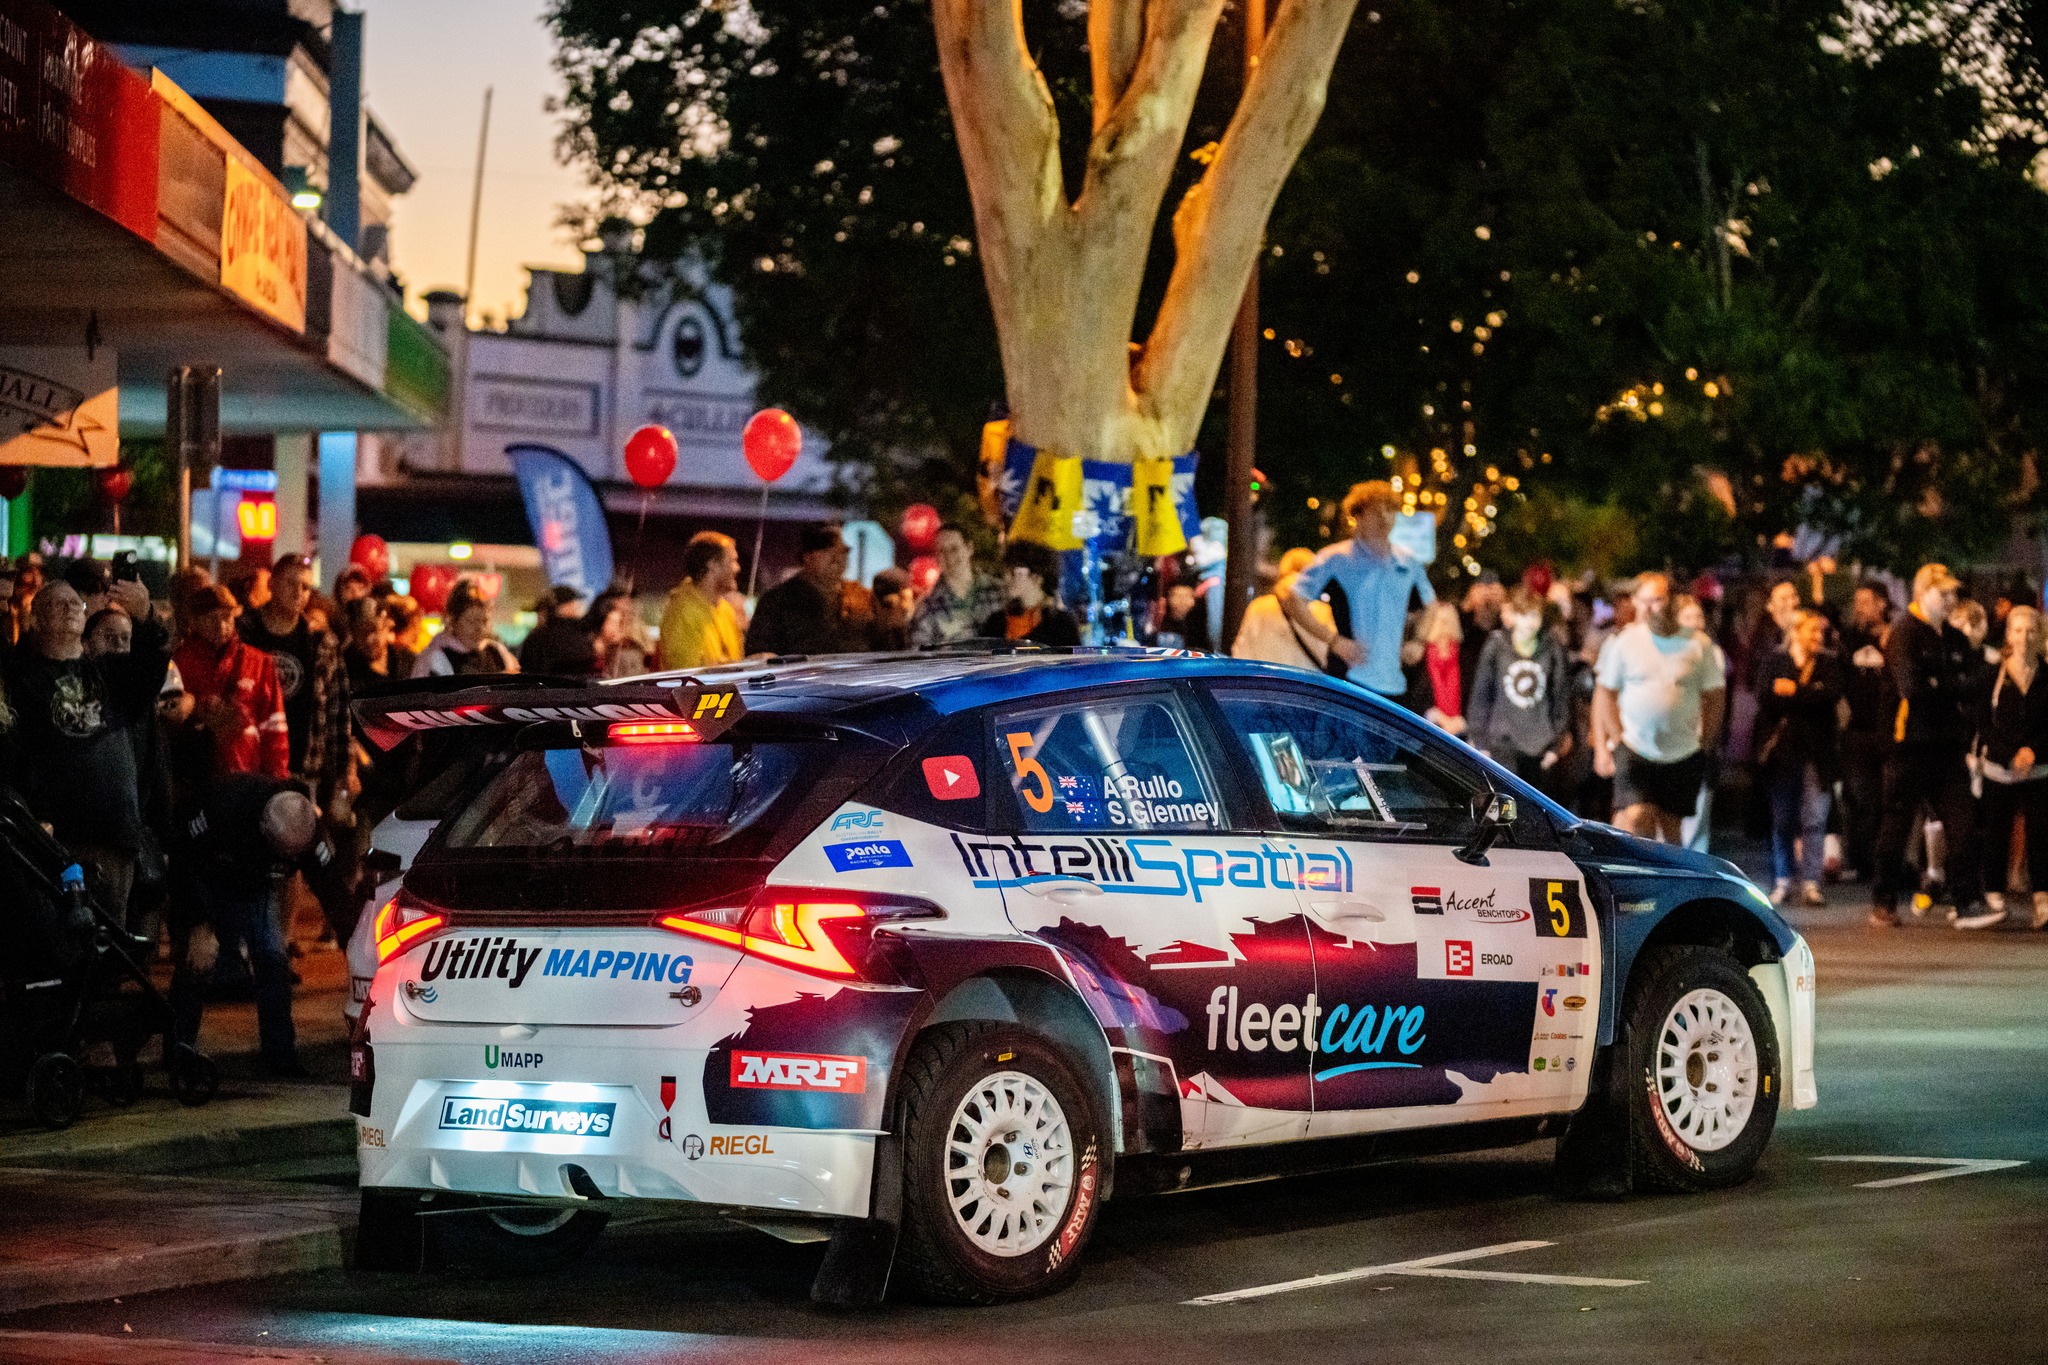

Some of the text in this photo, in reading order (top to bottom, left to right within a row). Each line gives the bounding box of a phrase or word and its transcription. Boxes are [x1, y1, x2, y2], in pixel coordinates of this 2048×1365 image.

[1006, 732, 1054, 813] 5
[1104, 775, 1182, 800] A.Rullo
[1109, 800, 1219, 826] S.Glenney
[1446, 888, 1497, 910] Accent
[1477, 907, 1521, 919] BENCHTOPS
[1547, 882, 1571, 937] 5
[421, 936, 694, 988] Utility MAPPING
[1481, 953, 1513, 966] EROAD
[1206, 985, 1427, 1055] fleetcare
[738, 1055, 858, 1088] MRF
[709, 1134, 775, 1156] RIEGL
[1065, 1192, 1093, 1245] MRF
